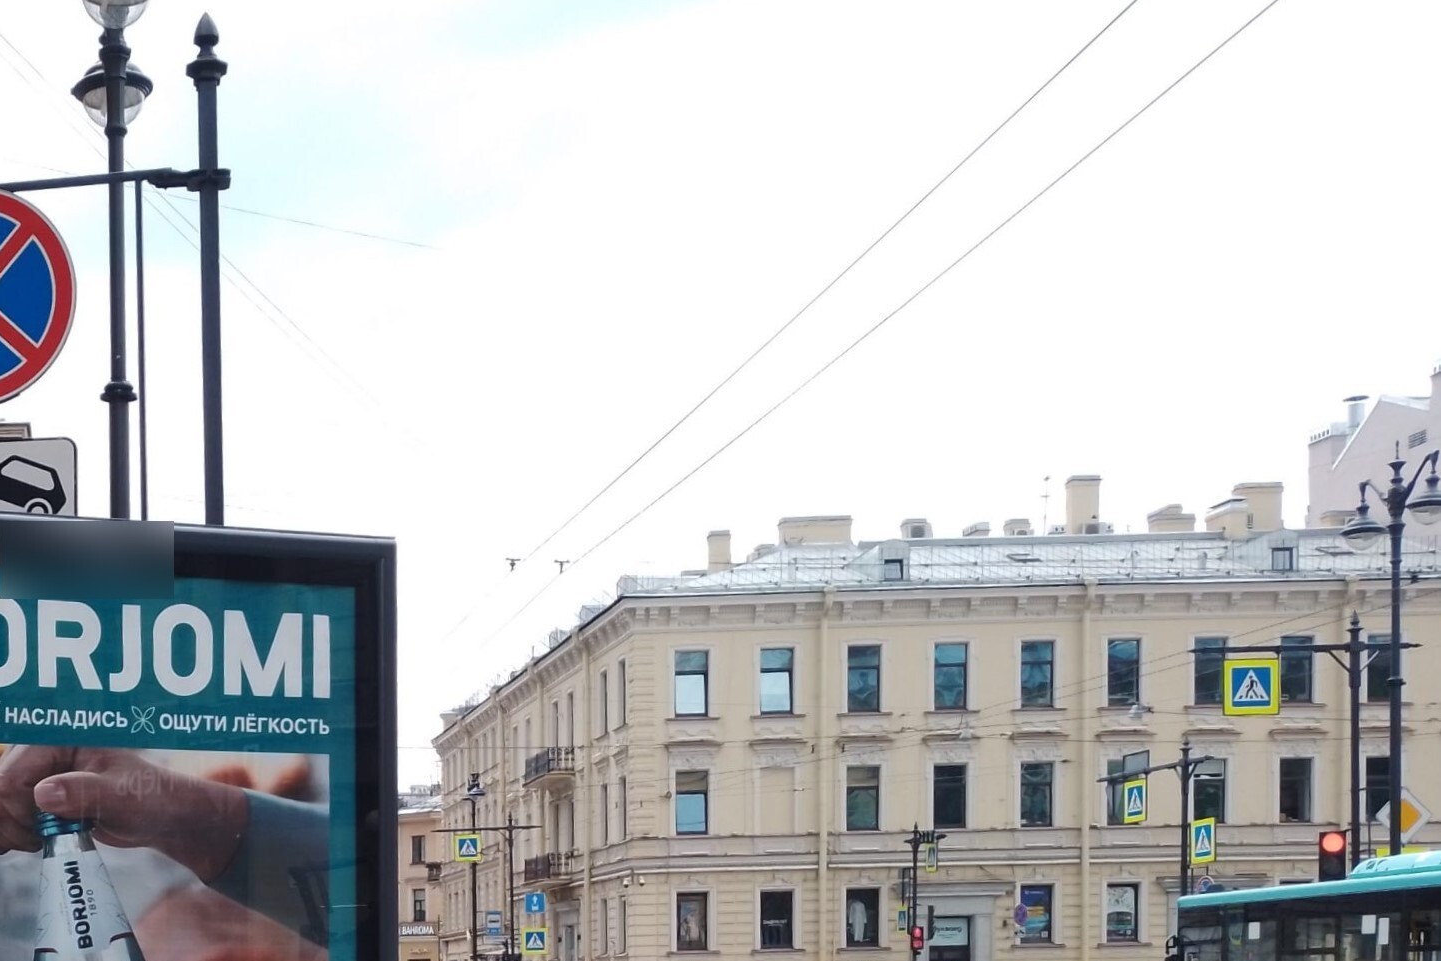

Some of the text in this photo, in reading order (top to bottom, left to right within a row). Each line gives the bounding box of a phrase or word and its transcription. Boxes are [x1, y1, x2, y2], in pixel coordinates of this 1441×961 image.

[5, 707, 128, 729] НАСЛАДИСЬ
[159, 713, 227, 733] ОЩУТИ
[232, 713, 330, 735] ЛЁГКОСТЬ
[64, 861, 93, 949] BORJOMI
[86, 889, 98, 916] 1890
